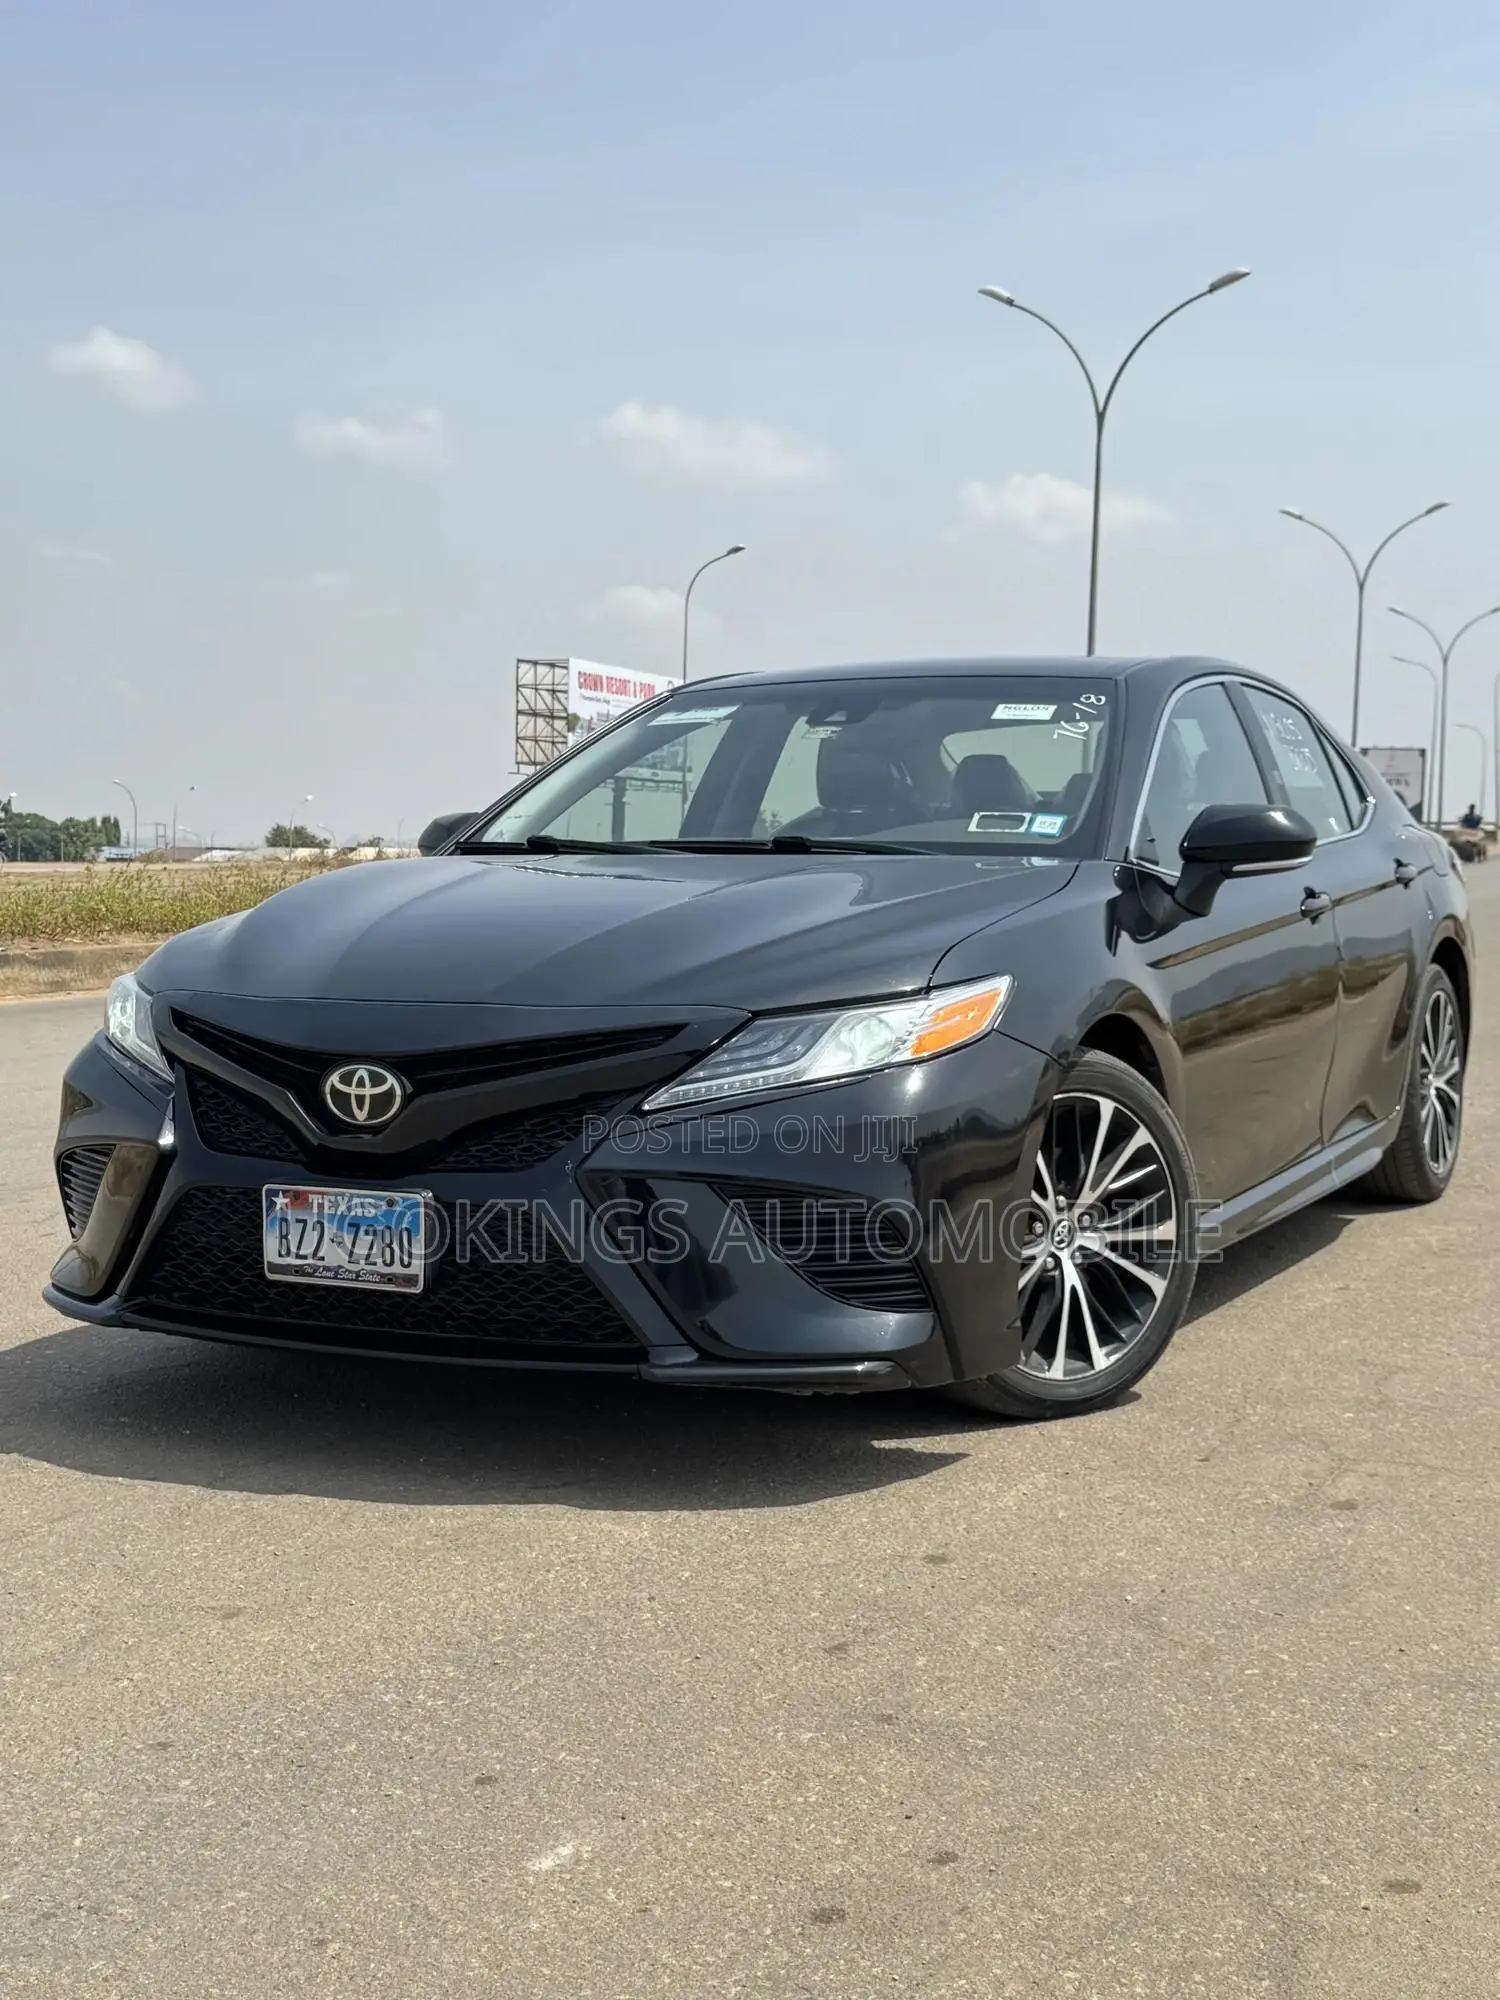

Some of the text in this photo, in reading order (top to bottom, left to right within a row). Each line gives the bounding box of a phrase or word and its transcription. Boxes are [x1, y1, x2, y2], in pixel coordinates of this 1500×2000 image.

[578, 671, 604, 693] CROWN
[605, 675, 631, 697] RESORT
[308, 1194, 377, 1218] TEXAS
[303, 1265, 382, 1283] The Lone Star State
